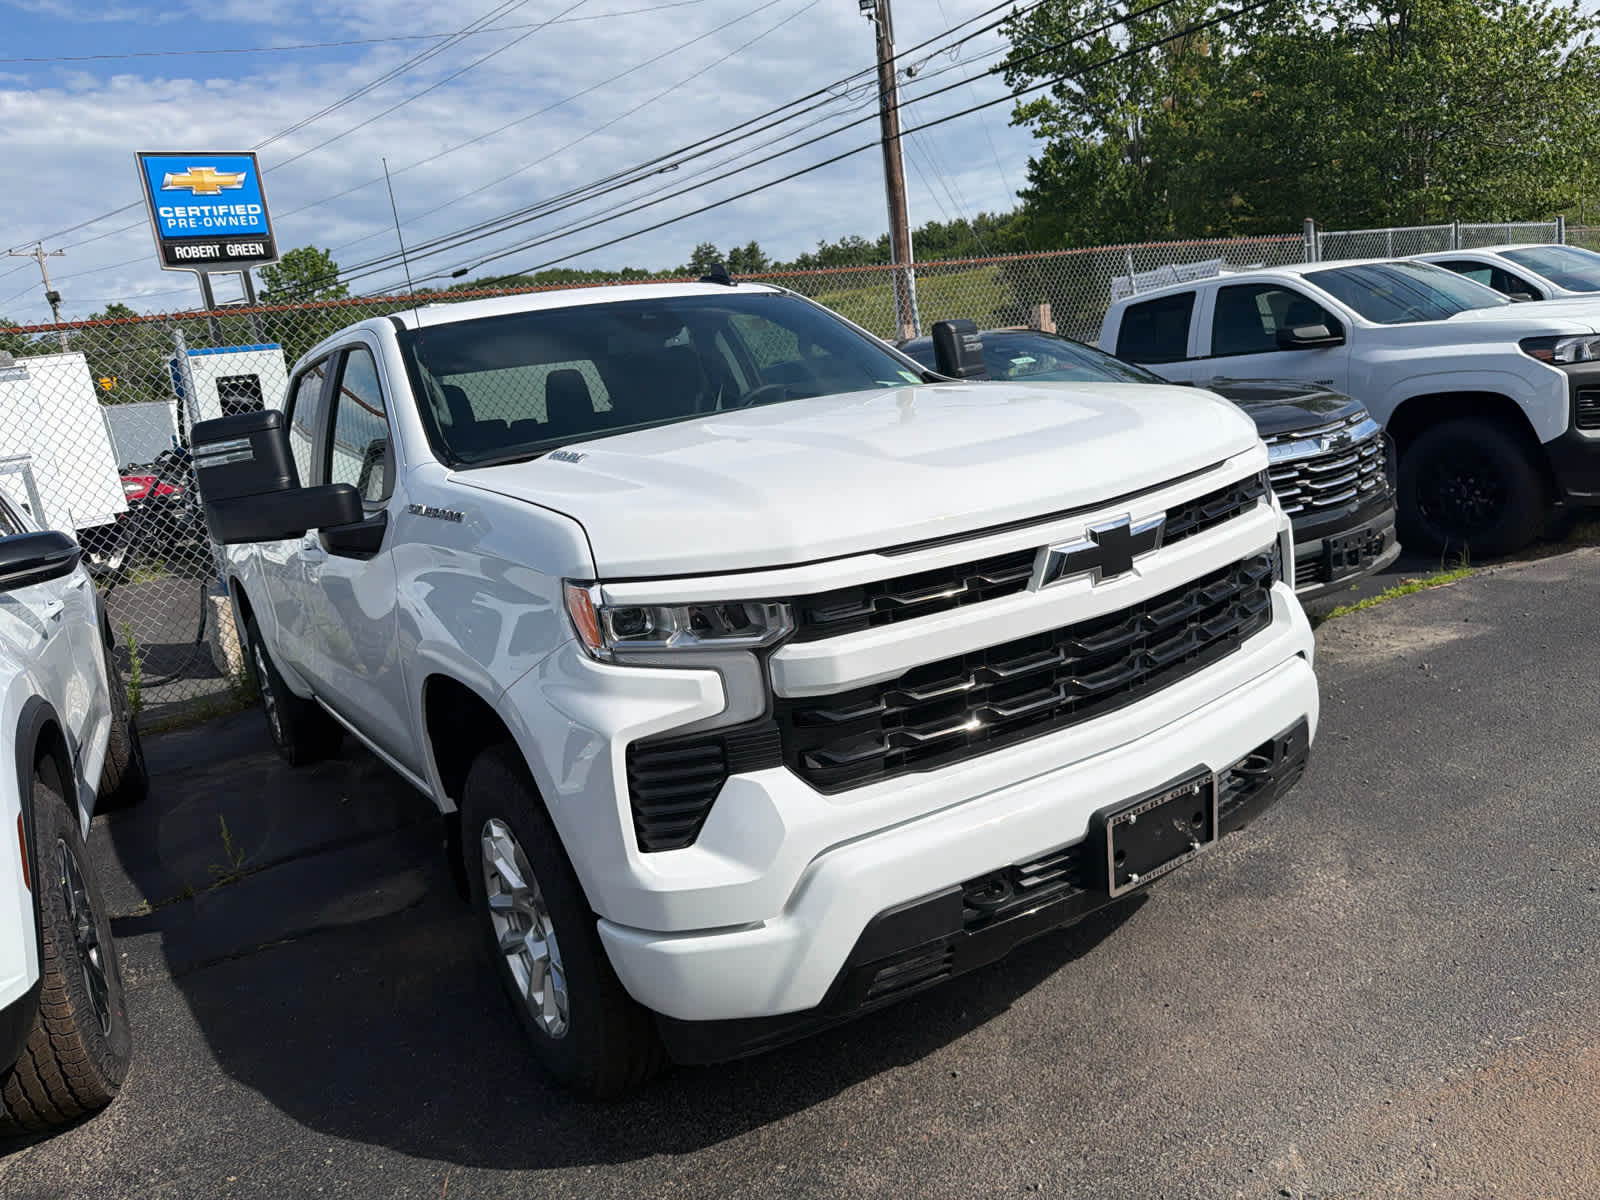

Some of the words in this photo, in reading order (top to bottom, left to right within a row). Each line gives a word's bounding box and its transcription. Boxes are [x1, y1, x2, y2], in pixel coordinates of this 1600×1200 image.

[159, 204, 261, 217] CERTIFIED
[167, 216, 259, 229] PRE-OWNED
[174, 245, 220, 259] ROBERT
[226, 243, 265, 256] GREEN
